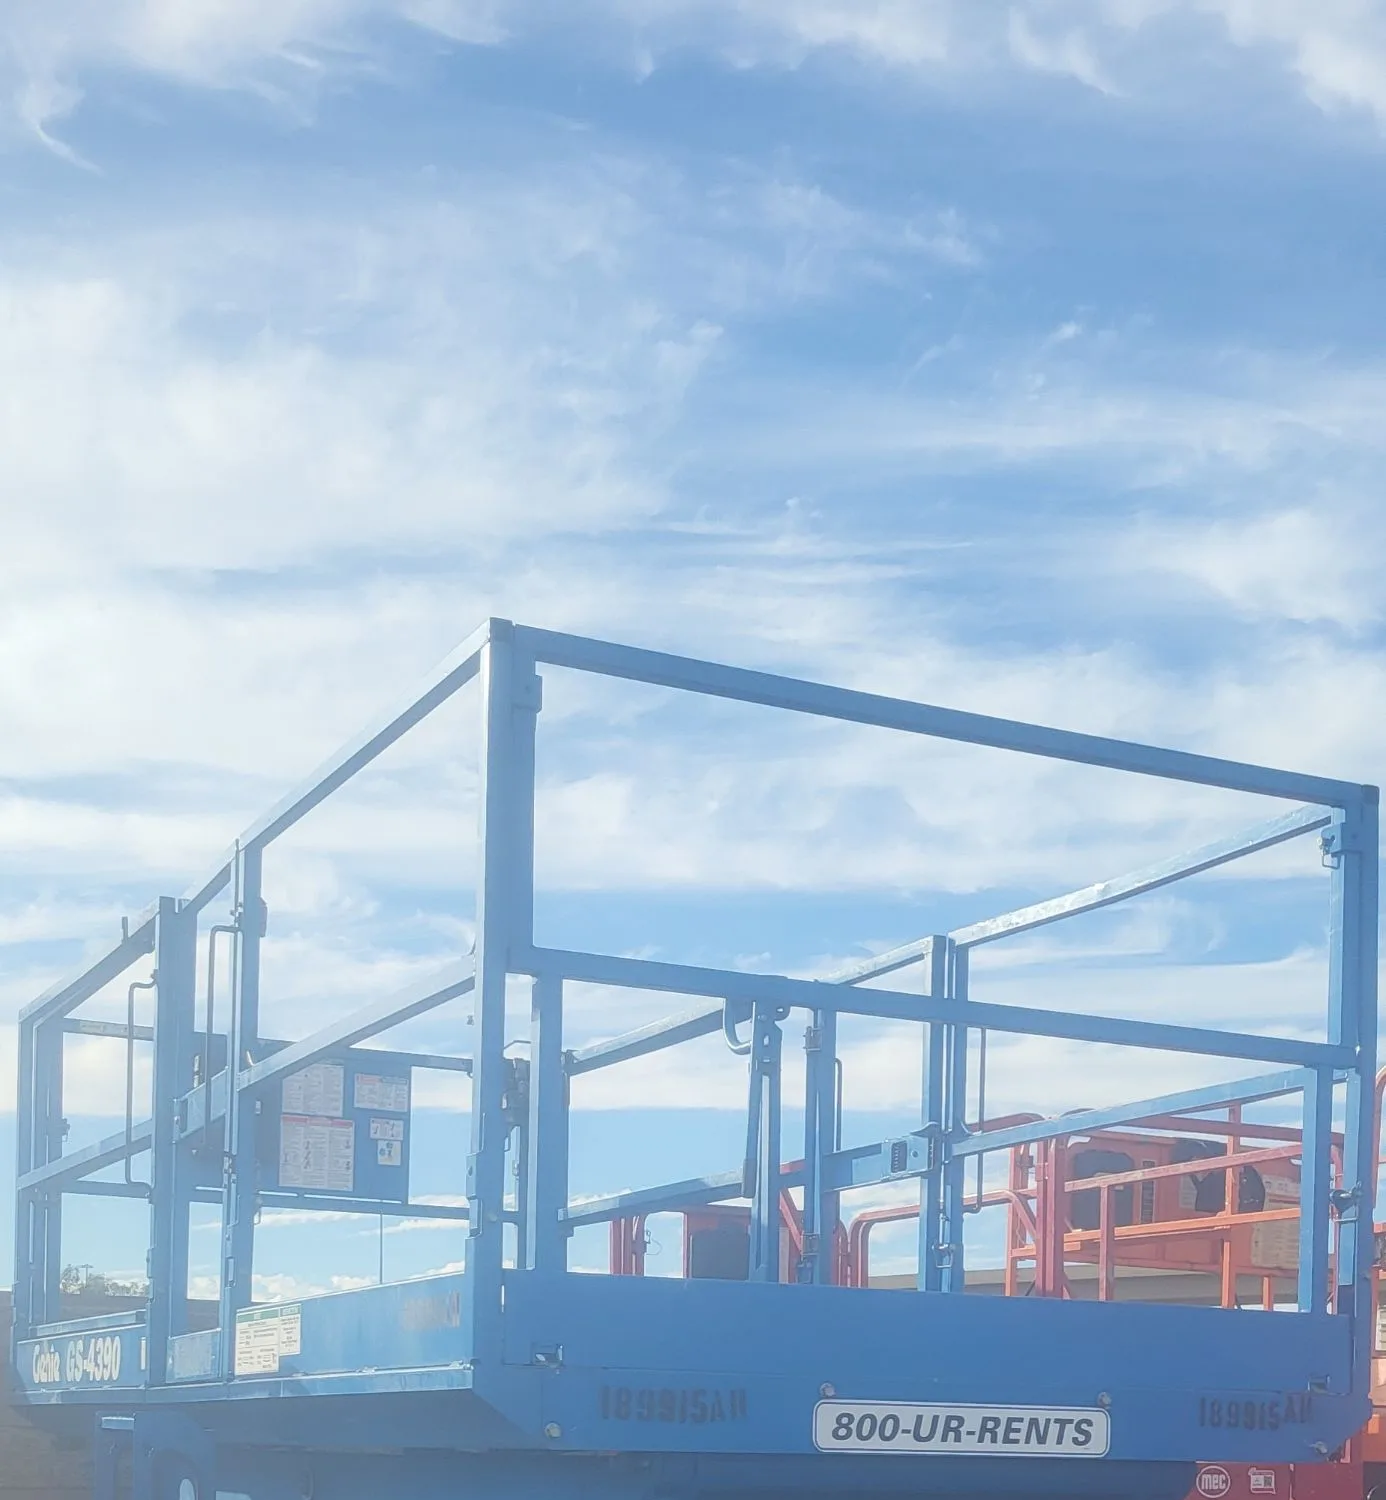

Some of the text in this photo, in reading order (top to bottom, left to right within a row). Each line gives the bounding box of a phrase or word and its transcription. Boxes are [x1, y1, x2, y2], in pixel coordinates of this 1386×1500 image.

[33, 1336, 121, 1383] Genie GS-4390
[831, 1412, 1094, 1446] 800-UR-RENTS
